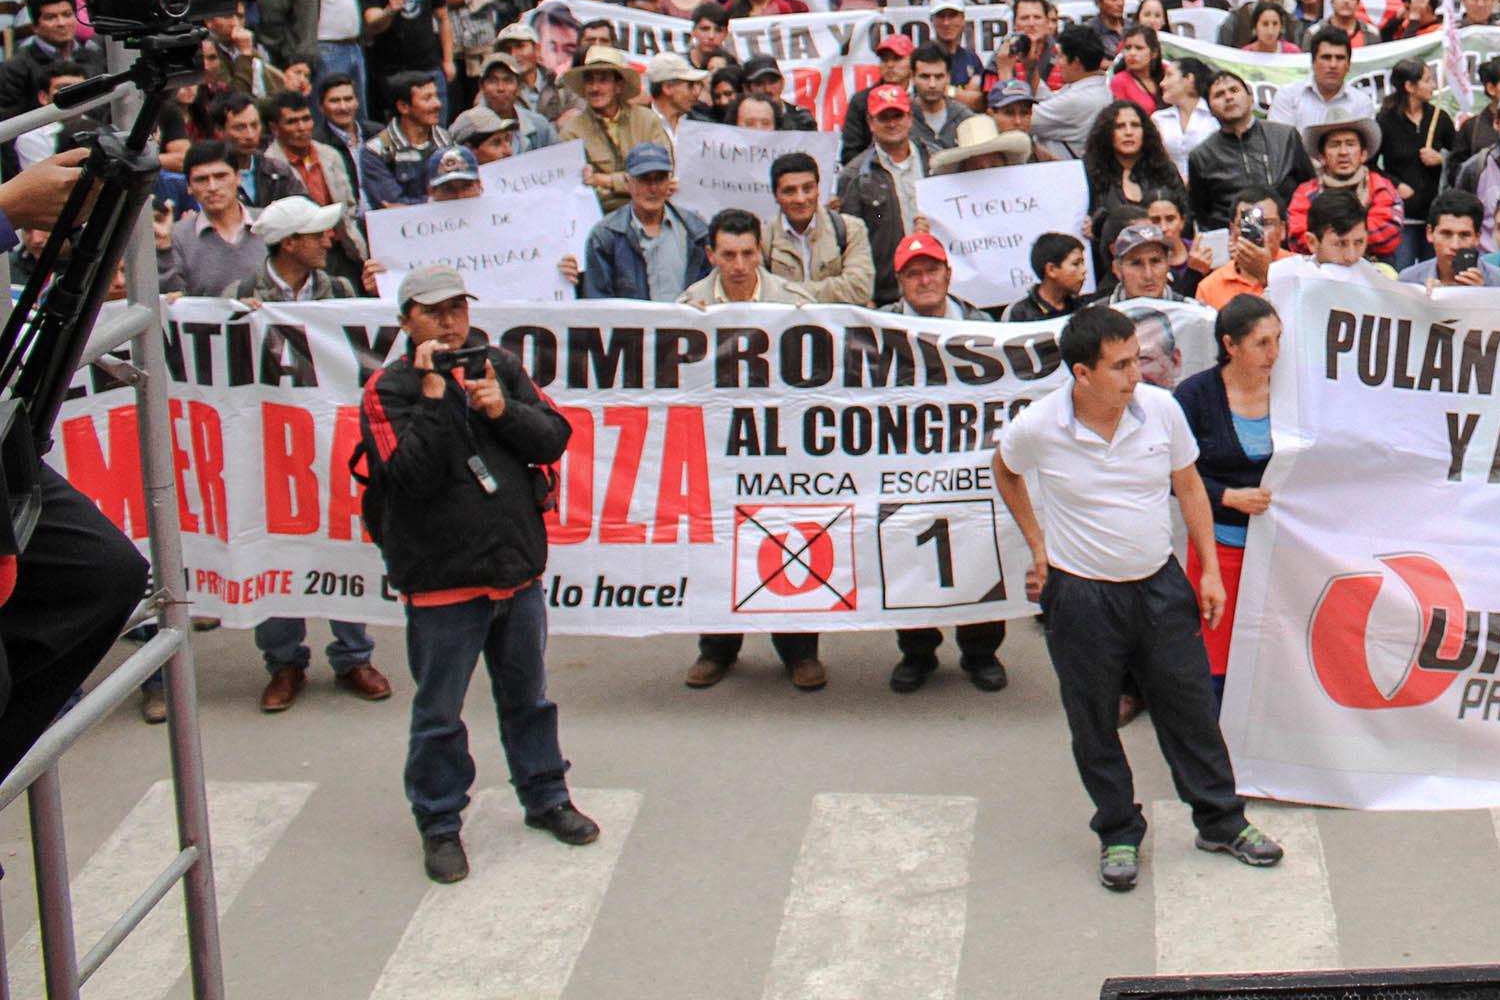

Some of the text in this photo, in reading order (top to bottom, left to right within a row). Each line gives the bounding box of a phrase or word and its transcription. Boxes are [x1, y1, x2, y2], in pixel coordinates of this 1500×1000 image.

[343, 326, 400, 388] Y
[501, 324, 1063, 388] OMPROMISO
[725, 407, 787, 456] AL
[1445, 412, 1481, 483] Y
[261, 401, 715, 545] BAOZA
[737, 467, 993, 496] MARCA ESCRIBE
[916, 518, 954, 588] 1
[304, 570, 365, 598] 2016
[592, 575, 688, 608] hace!
